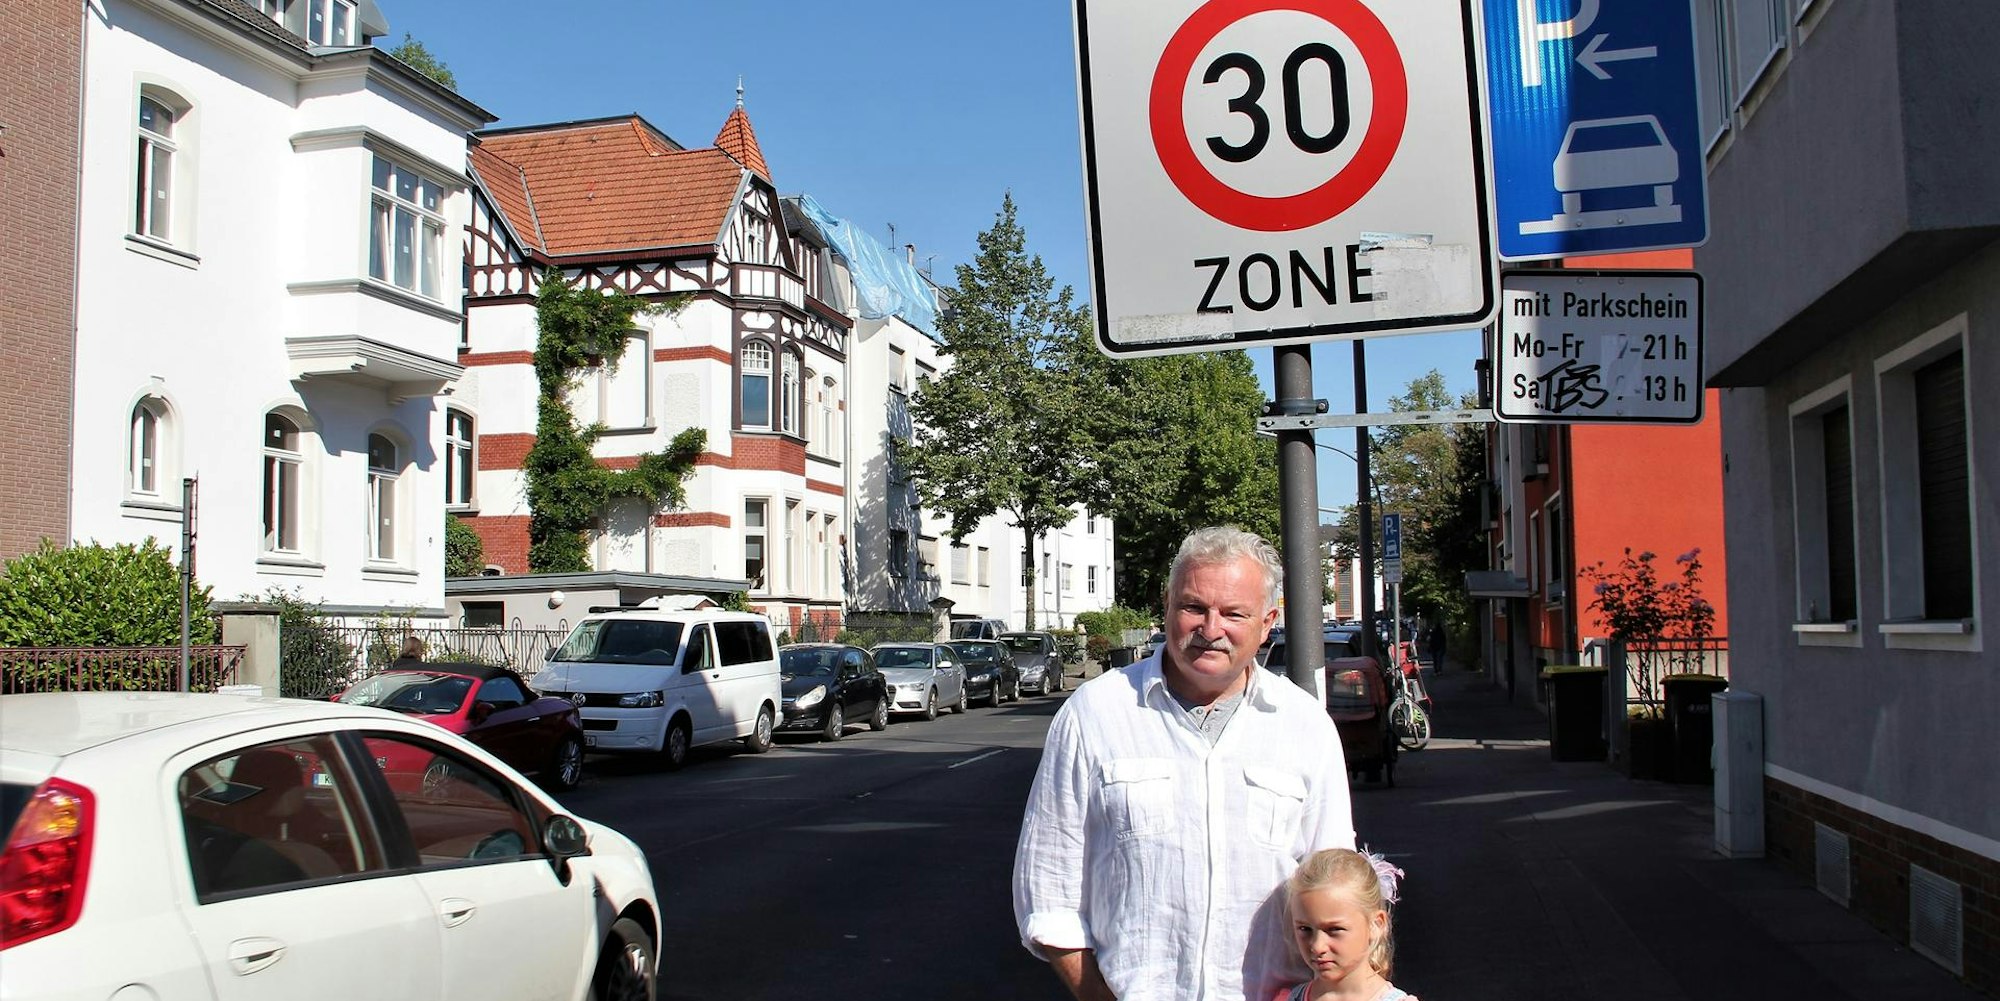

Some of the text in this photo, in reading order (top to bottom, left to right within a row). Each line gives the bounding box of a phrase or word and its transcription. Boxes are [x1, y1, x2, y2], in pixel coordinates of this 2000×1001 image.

[1517, 0, 1600, 88] P
[1203, 42, 1350, 163] 30
[1194, 244, 1384, 314] ZONE
[1513, 291, 1688, 319] mit Parkschein
[1513, 332, 1585, 359] Mo-Fr
[1674, 334, 1687, 360] h
[1513, 373, 1540, 399] Sa
[1673, 376, 1686, 402] h
[1385, 517, 1393, 535] P
